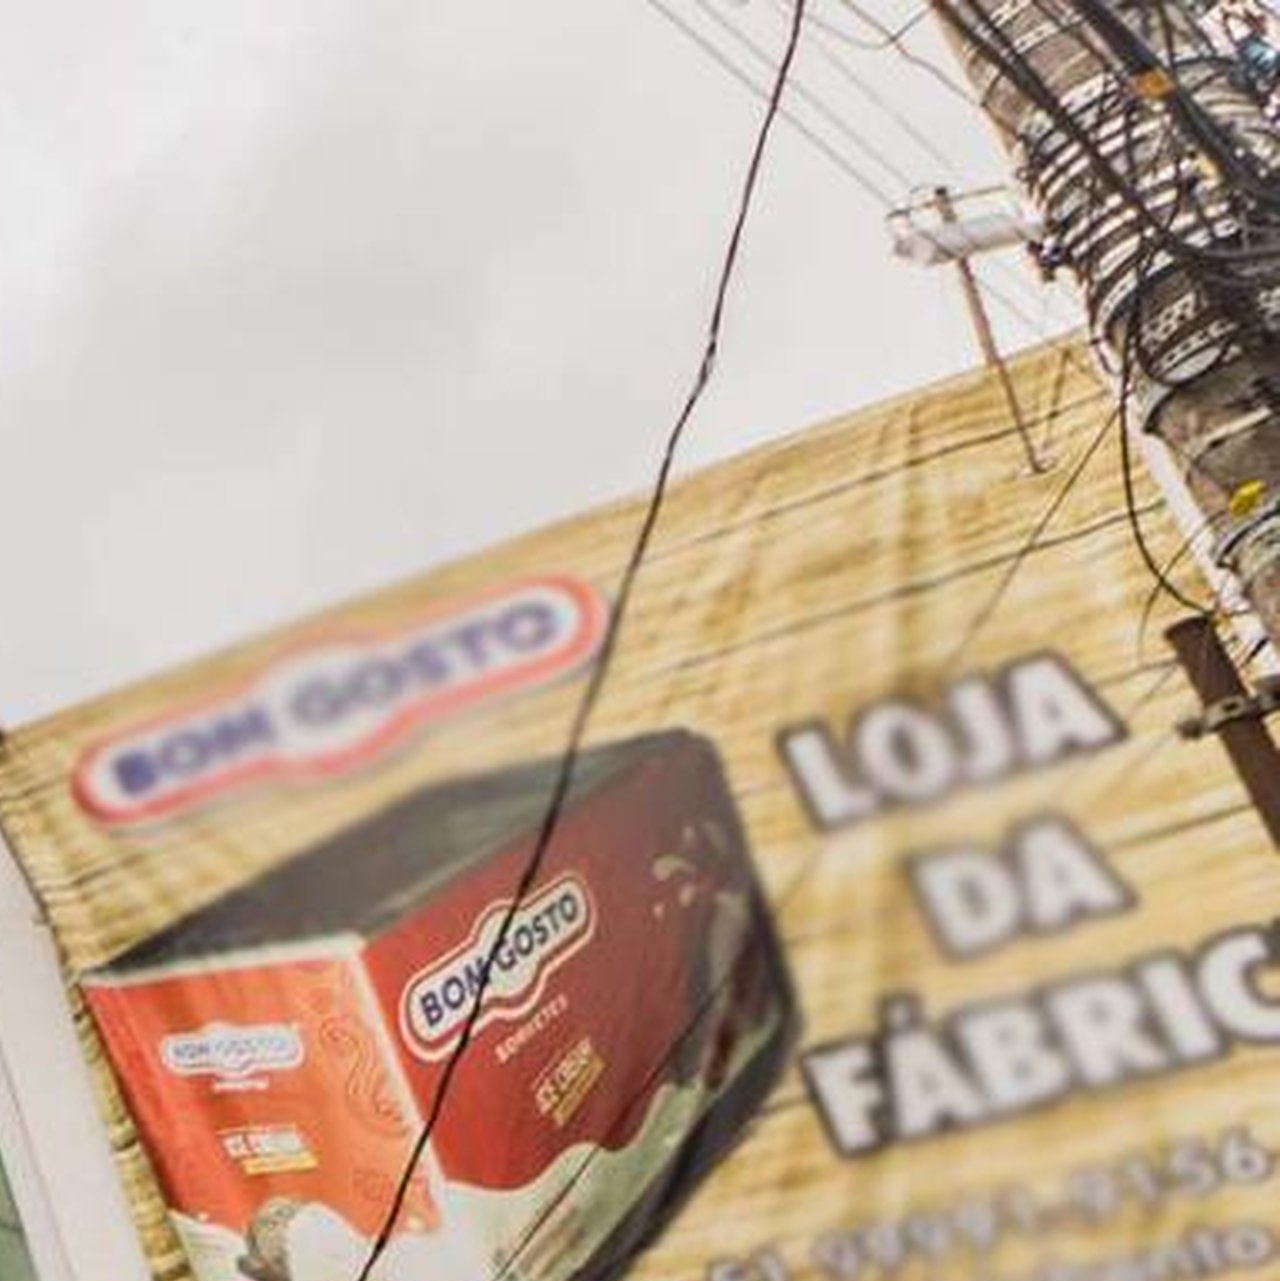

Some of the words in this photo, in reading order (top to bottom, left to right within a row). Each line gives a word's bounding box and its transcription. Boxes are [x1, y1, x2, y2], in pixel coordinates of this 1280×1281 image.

[112, 704, 274, 796] BOM
[290, 600, 558, 726] GOSTO
[778, 652, 1126, 829] LOJA
[420, 956, 491, 1027] BOM
[492, 893, 578, 971] GOSTO
[904, 815, 1136, 962] DA
